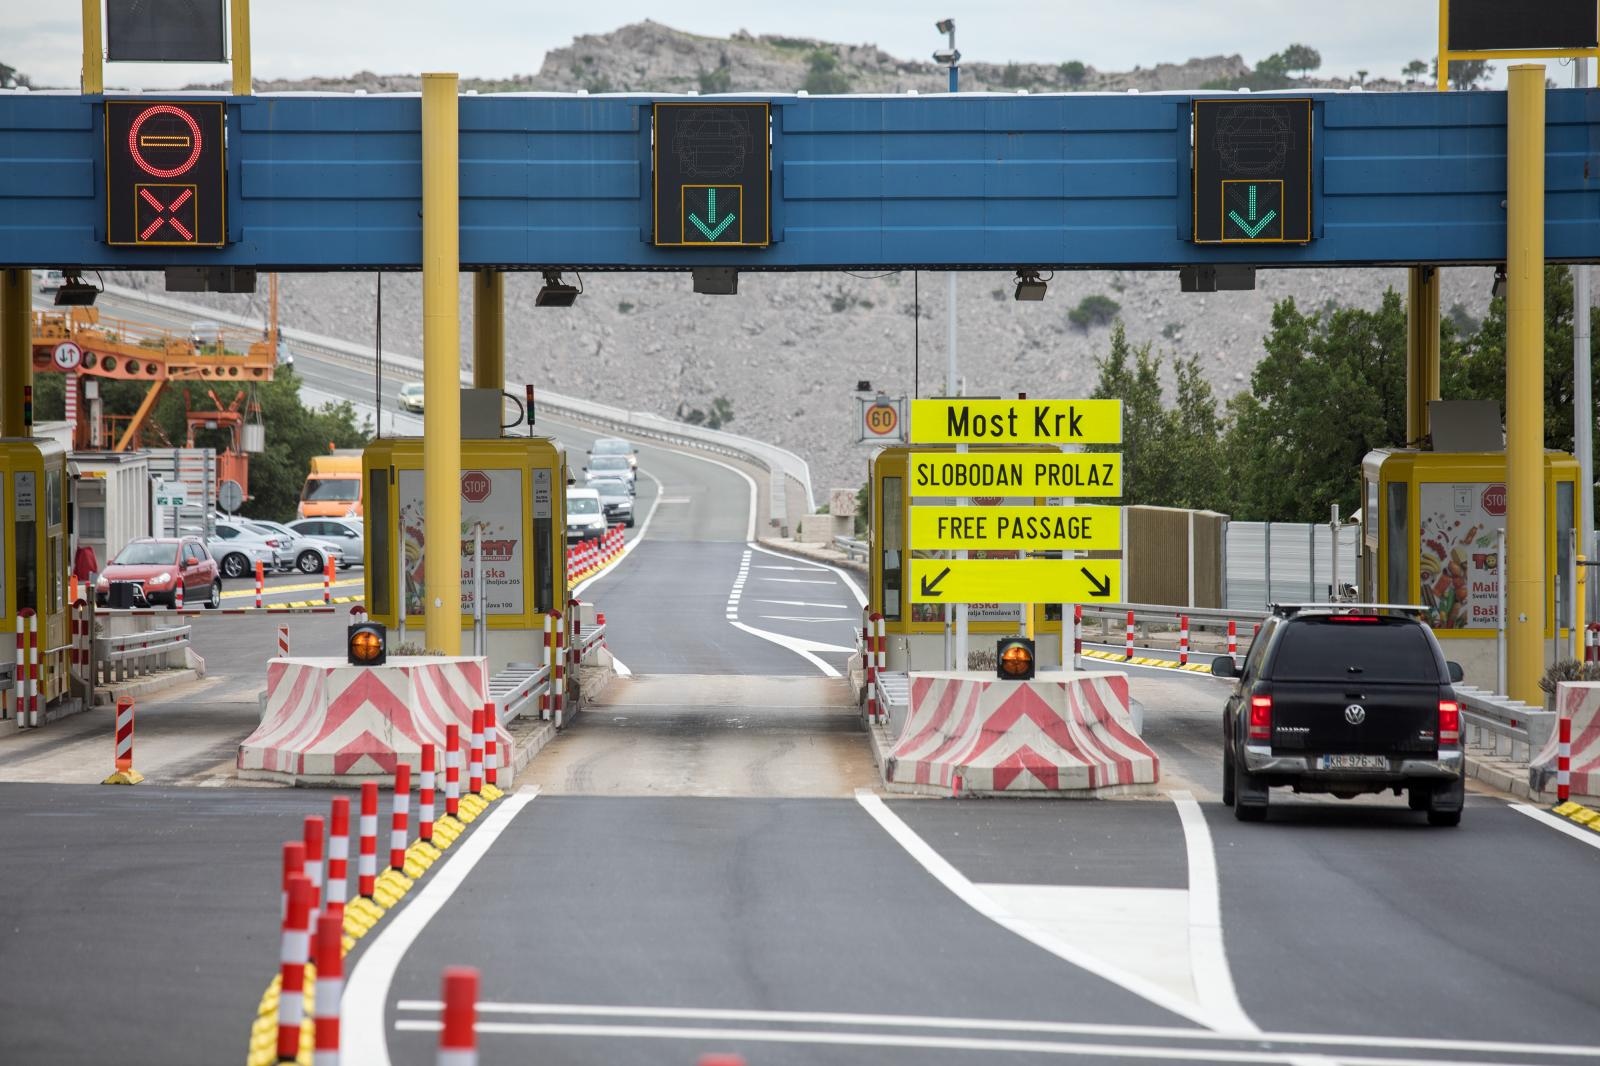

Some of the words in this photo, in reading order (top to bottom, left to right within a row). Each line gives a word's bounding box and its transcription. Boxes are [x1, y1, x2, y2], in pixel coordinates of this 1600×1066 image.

[871, 411, 891, 427] 60
[948, 406, 1018, 437] Most
[1034, 406, 1083, 437] Krk
[917, 463, 1022, 486] SLOBODAN
[1035, 463, 1113, 486] PROLAZ
[464, 480, 486, 493] STOP
[938, 516, 987, 539] FREE
[998, 516, 1092, 539] PASSAGE
[1472, 582, 1499, 592] Mali
